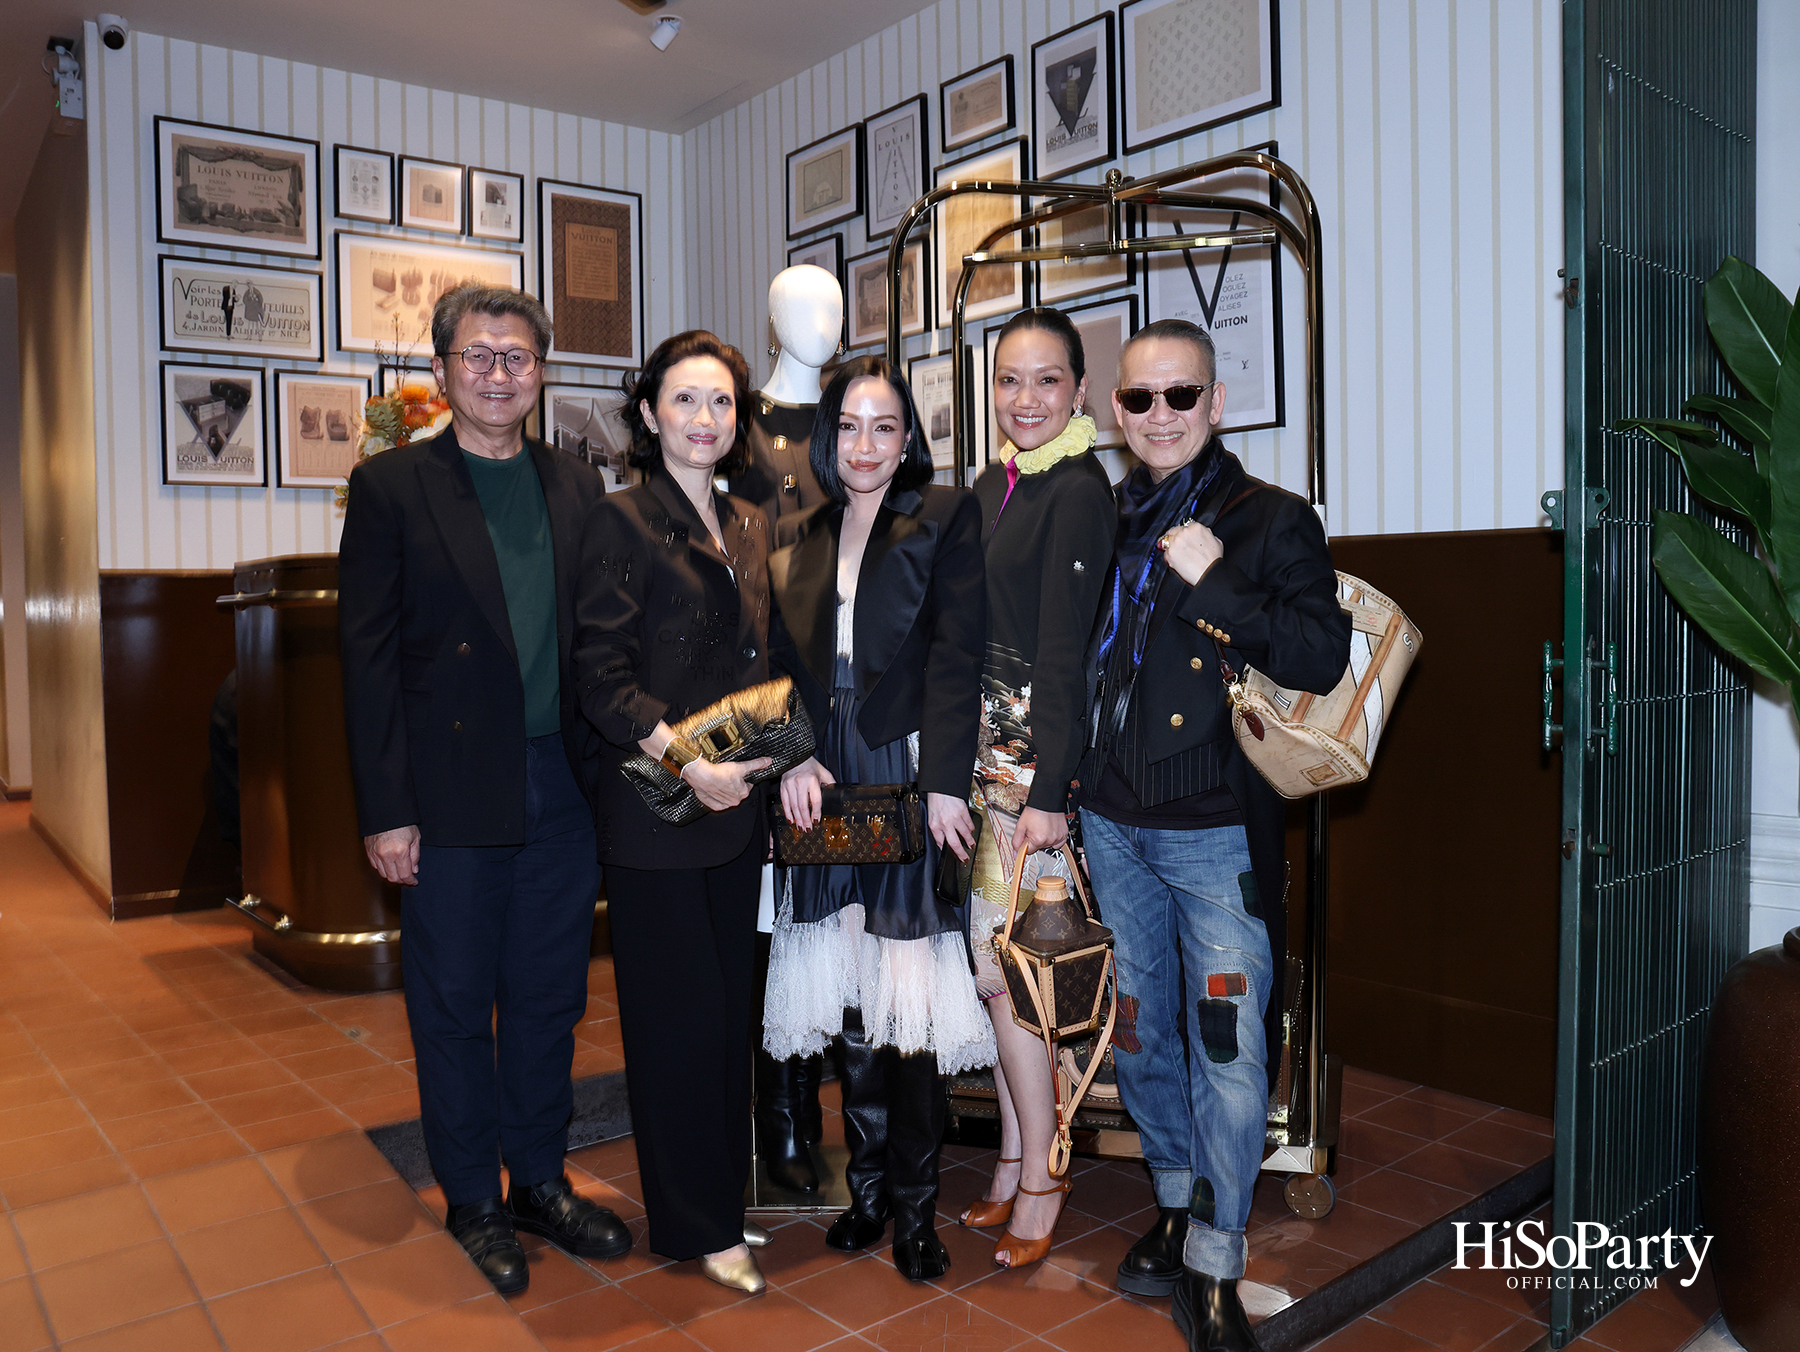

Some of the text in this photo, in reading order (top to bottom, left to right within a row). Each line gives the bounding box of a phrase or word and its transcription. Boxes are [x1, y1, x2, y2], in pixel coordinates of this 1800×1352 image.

[197, 165, 284, 184] LOUIS VUITTON
[571, 233, 613, 244] VUITTON
[263, 302, 305, 315] FEUILLES
[192, 322, 224, 333] JARDIN
[259, 313, 311, 332] VUITTON
[177, 455, 208, 463] LOUIS
